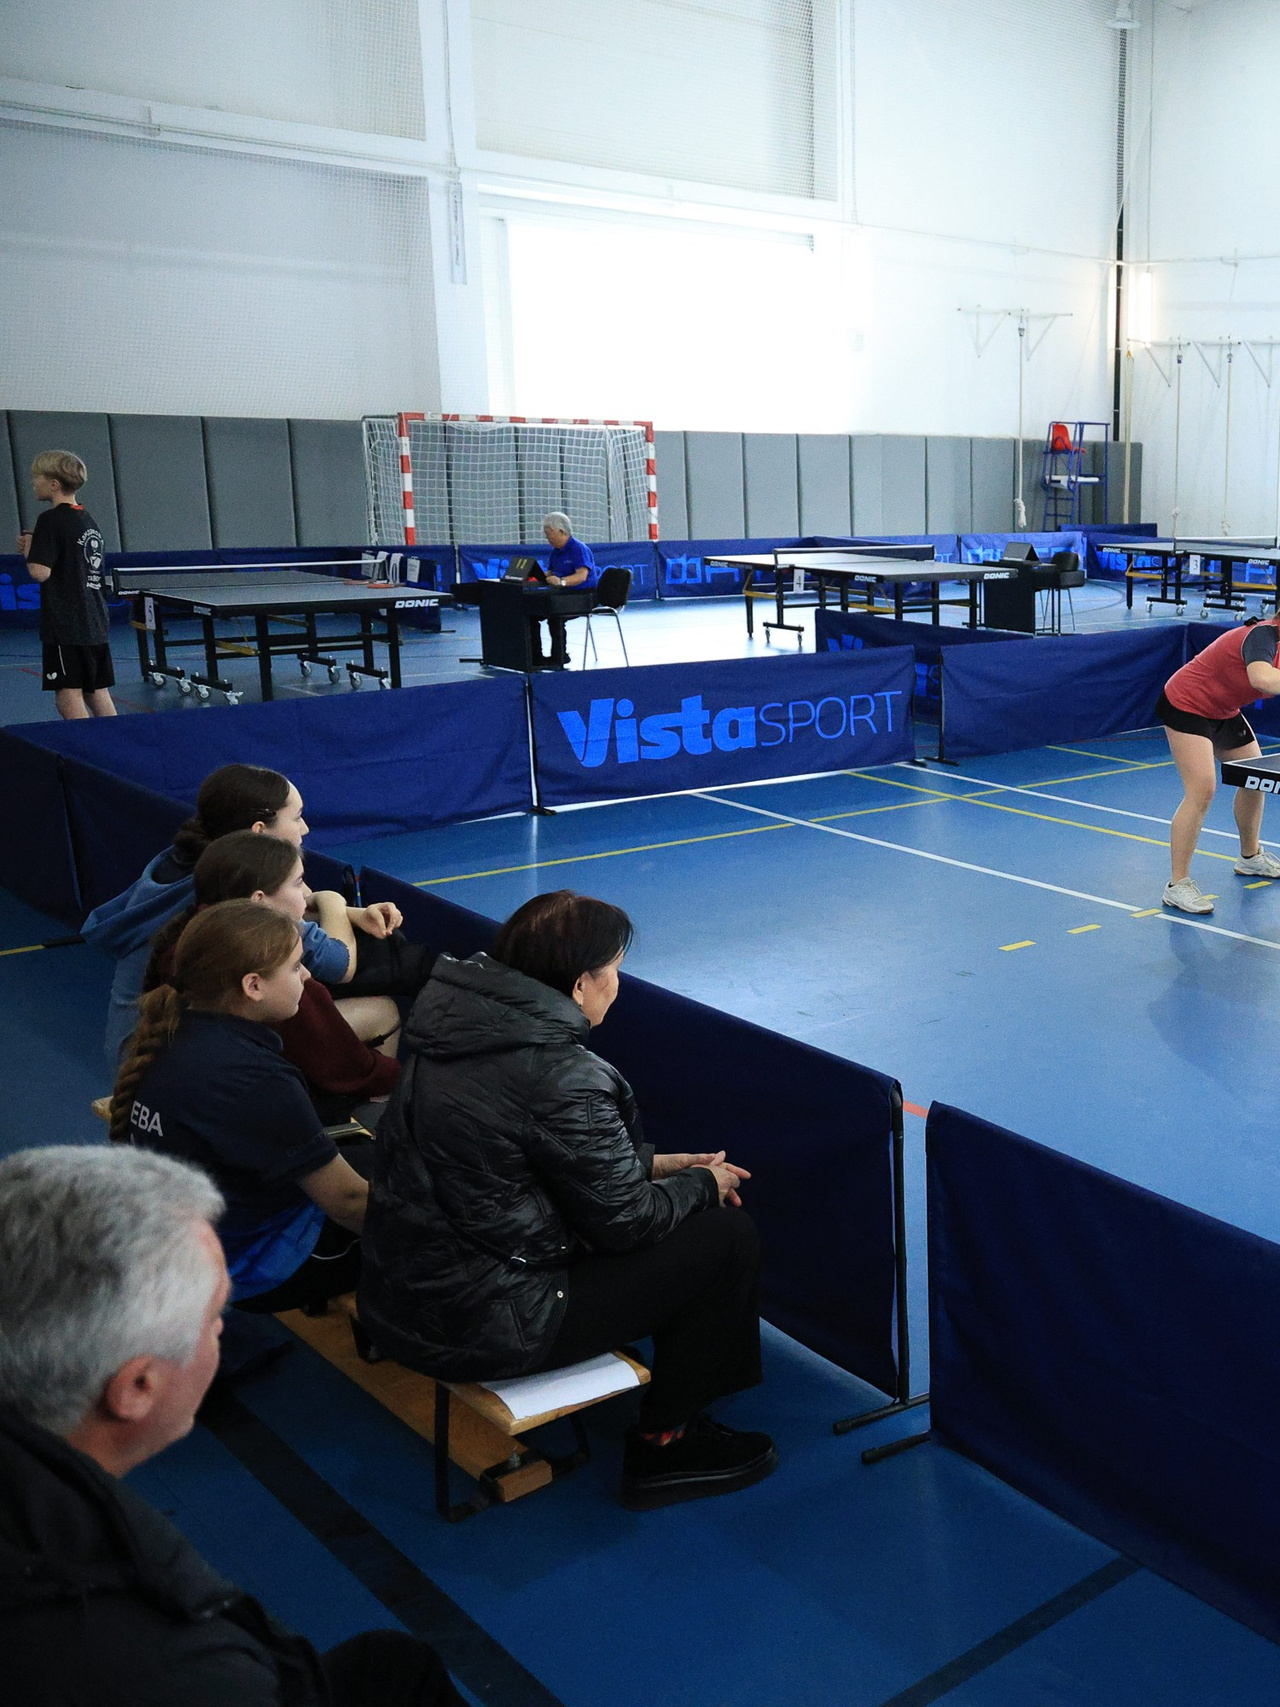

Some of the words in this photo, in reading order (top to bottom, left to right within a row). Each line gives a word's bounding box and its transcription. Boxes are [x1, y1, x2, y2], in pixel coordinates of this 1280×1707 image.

[1192, 560, 1199, 573] 3
[854, 575, 877, 583] DONIC
[984, 572, 1010, 580] DONIC
[395, 599, 439, 609] DONIC
[130, 1100, 163, 1137] ЕВА
